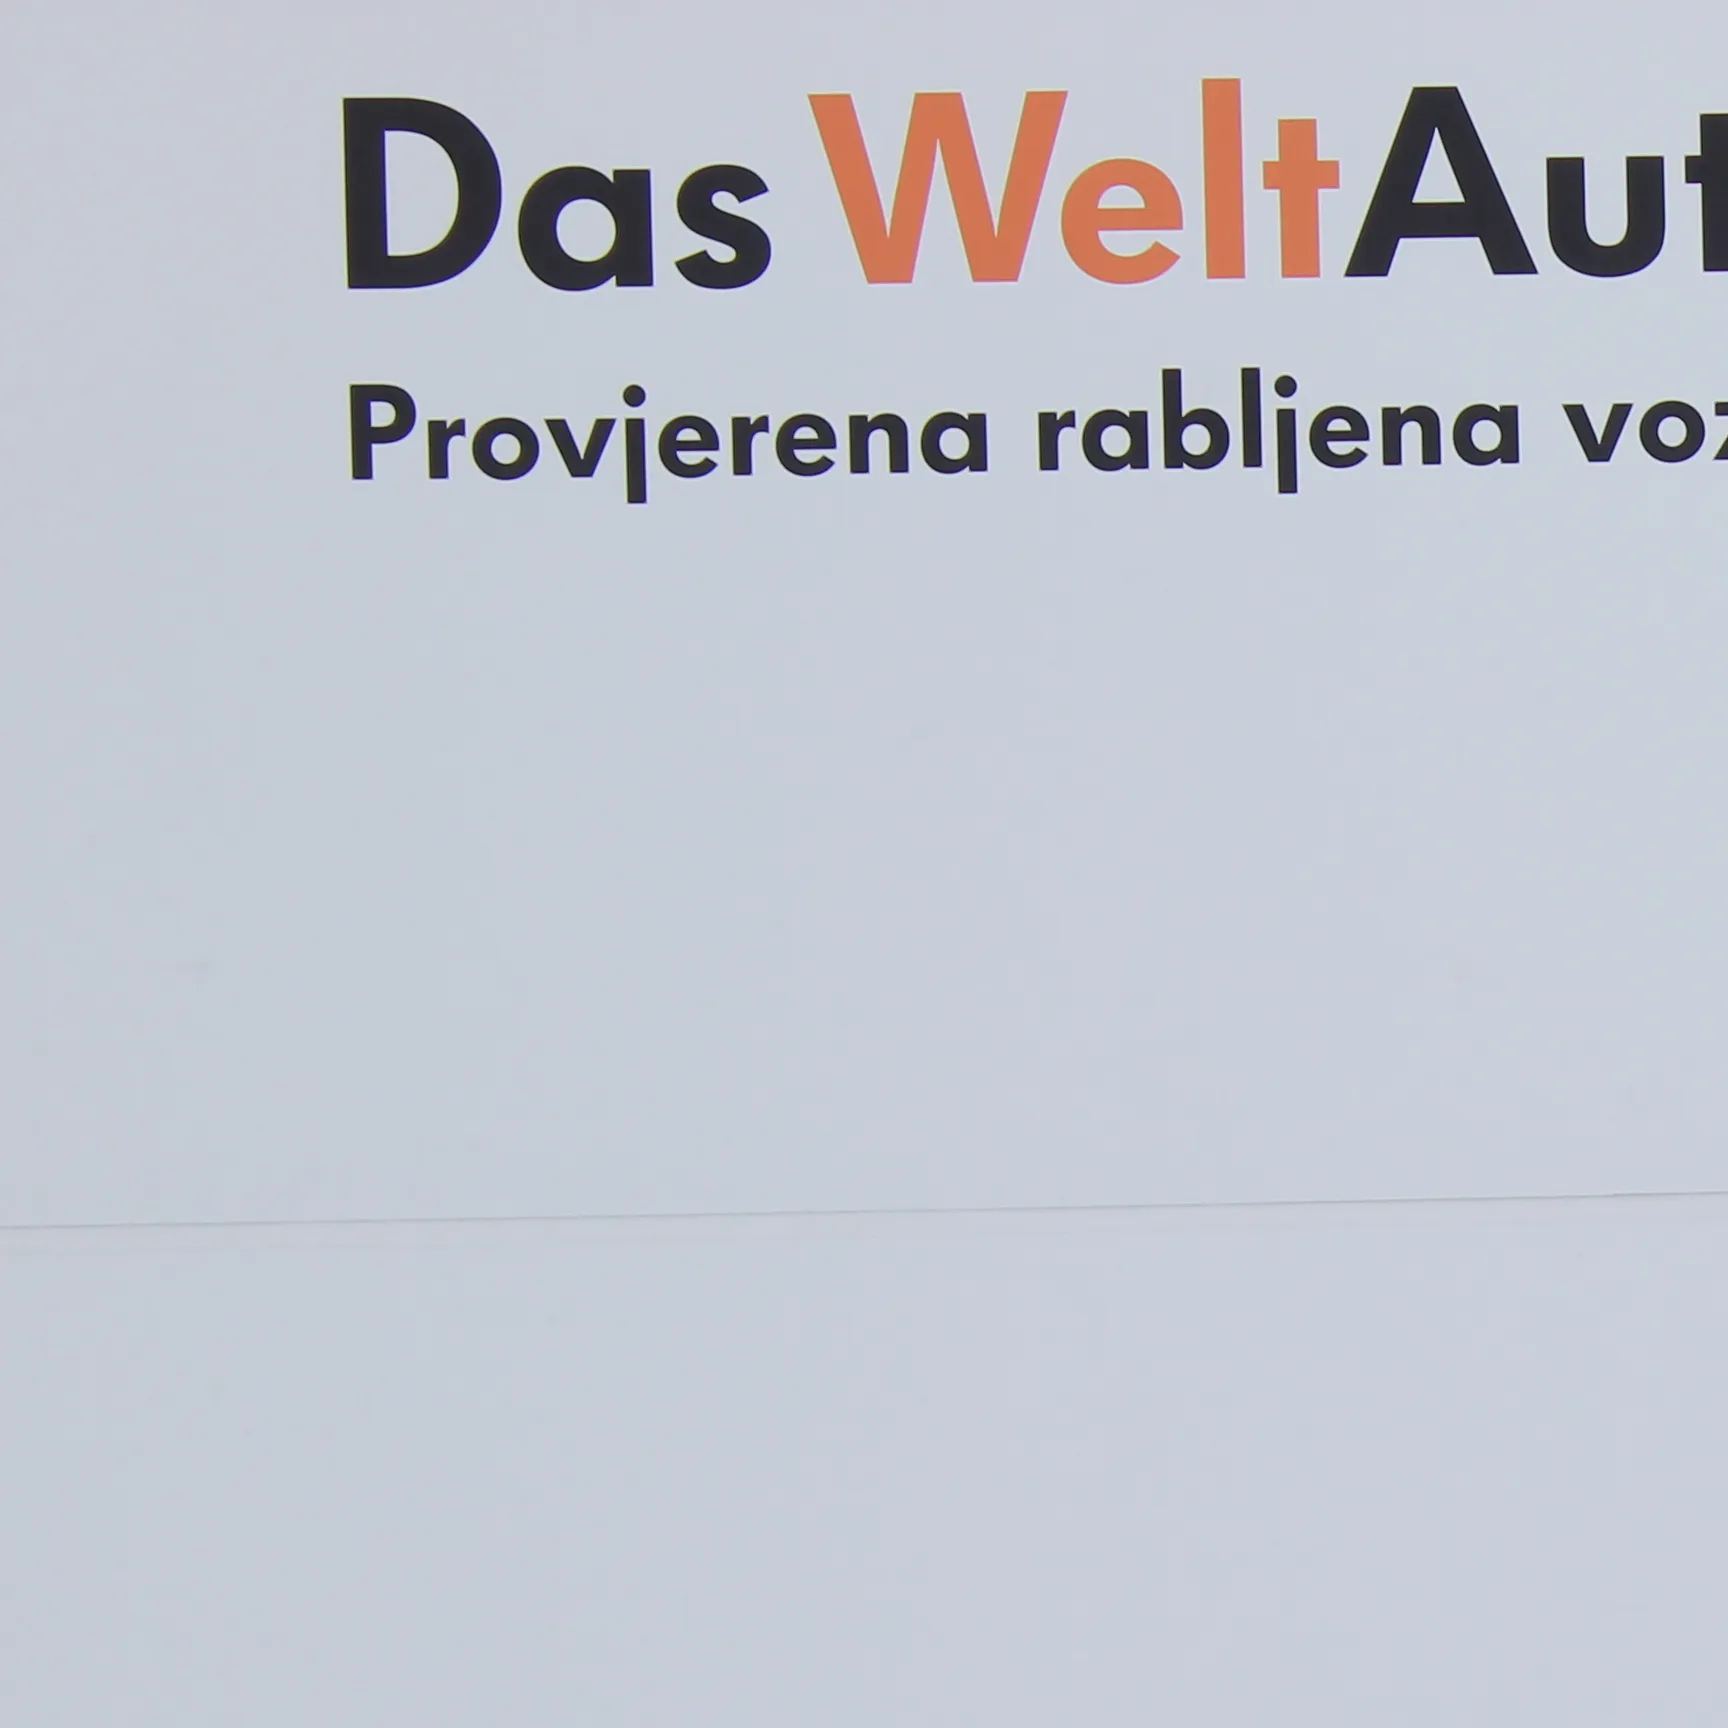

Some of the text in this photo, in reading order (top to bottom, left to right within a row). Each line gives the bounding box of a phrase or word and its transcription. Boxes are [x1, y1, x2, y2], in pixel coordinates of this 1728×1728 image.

[343, 97, 771, 291] Das
[350, 384, 987, 504] Provjerena
[1038, 368, 1519, 494] rabljena
